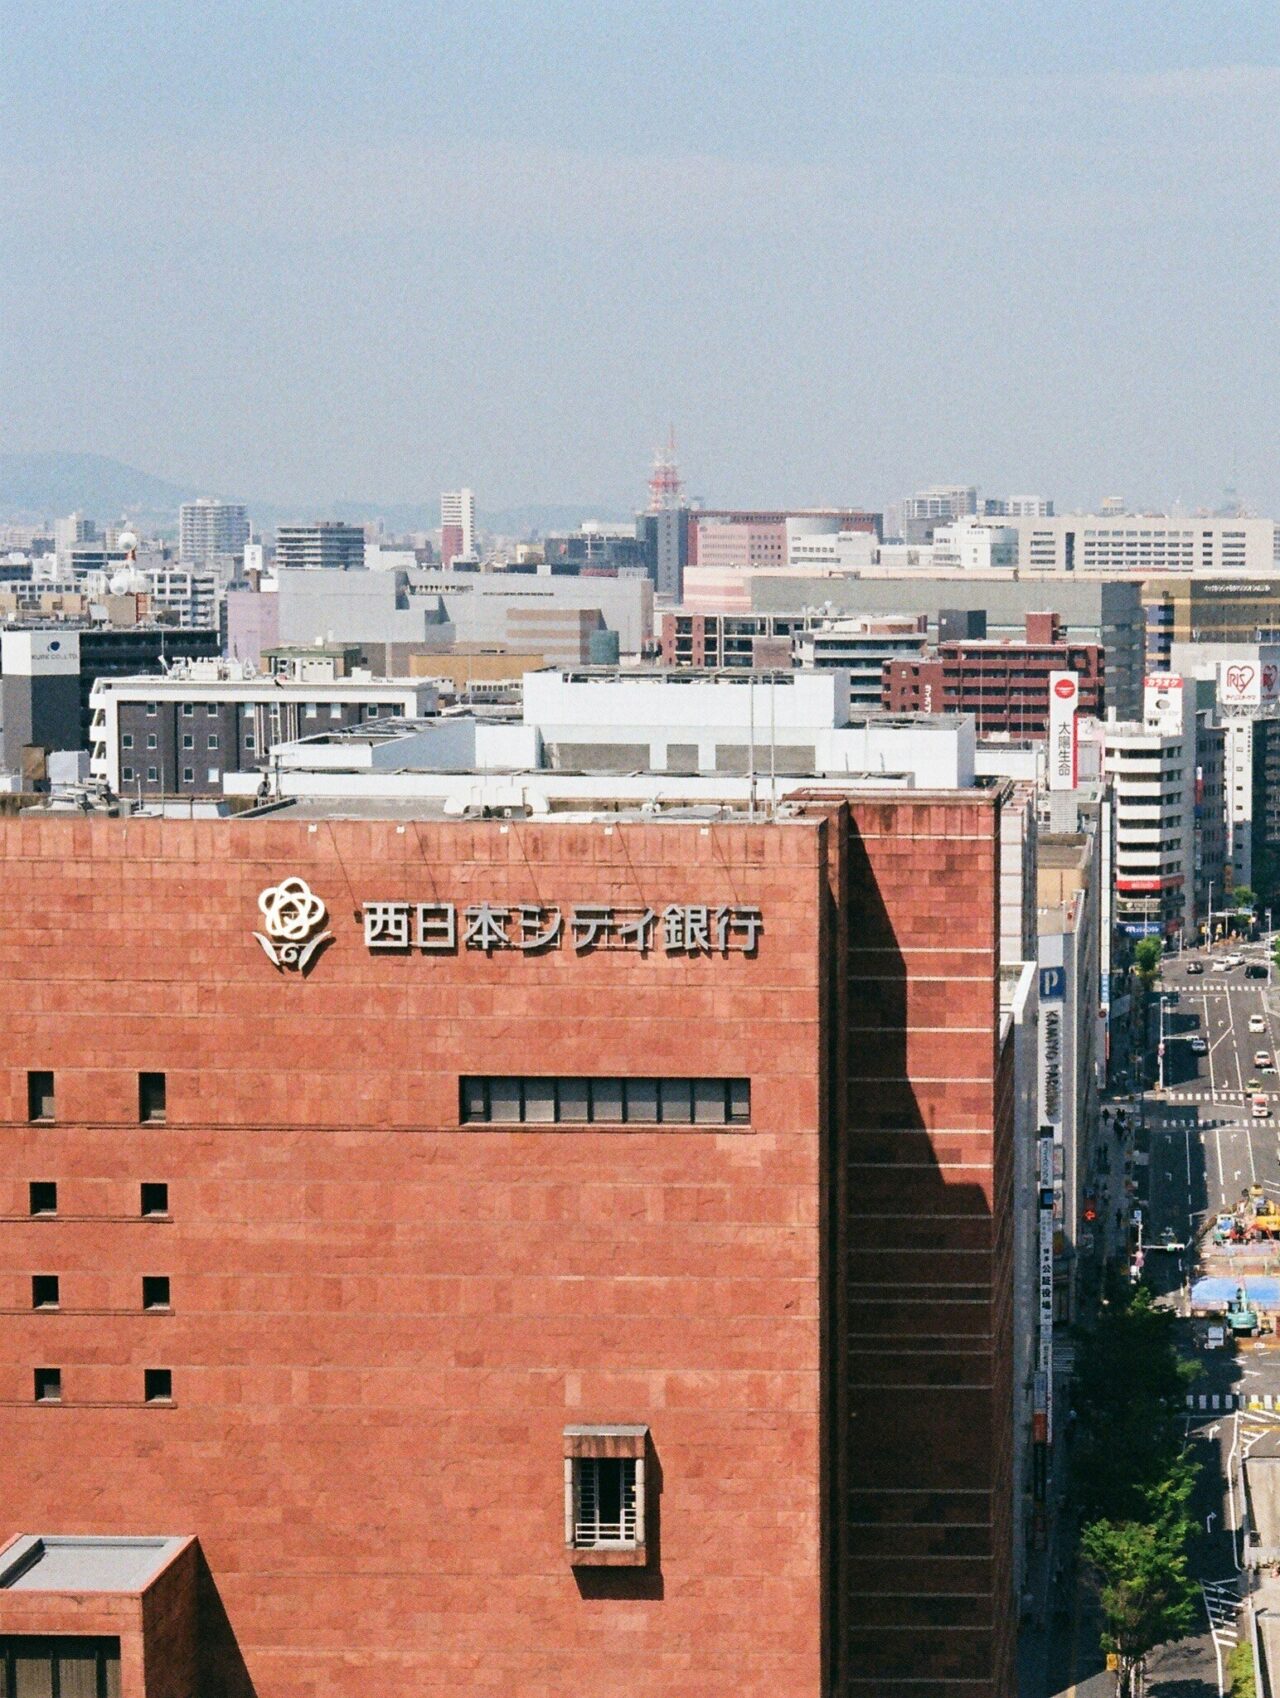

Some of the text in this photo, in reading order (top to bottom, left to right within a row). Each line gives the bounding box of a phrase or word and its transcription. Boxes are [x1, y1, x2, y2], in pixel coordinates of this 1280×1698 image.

[1147, 679, 1178, 687] カラオケ
[1058, 721, 1071, 776] 太陽生命
[362, 901, 763, 950] 西日本シティ銀行
[1044, 971, 1059, 995] P
